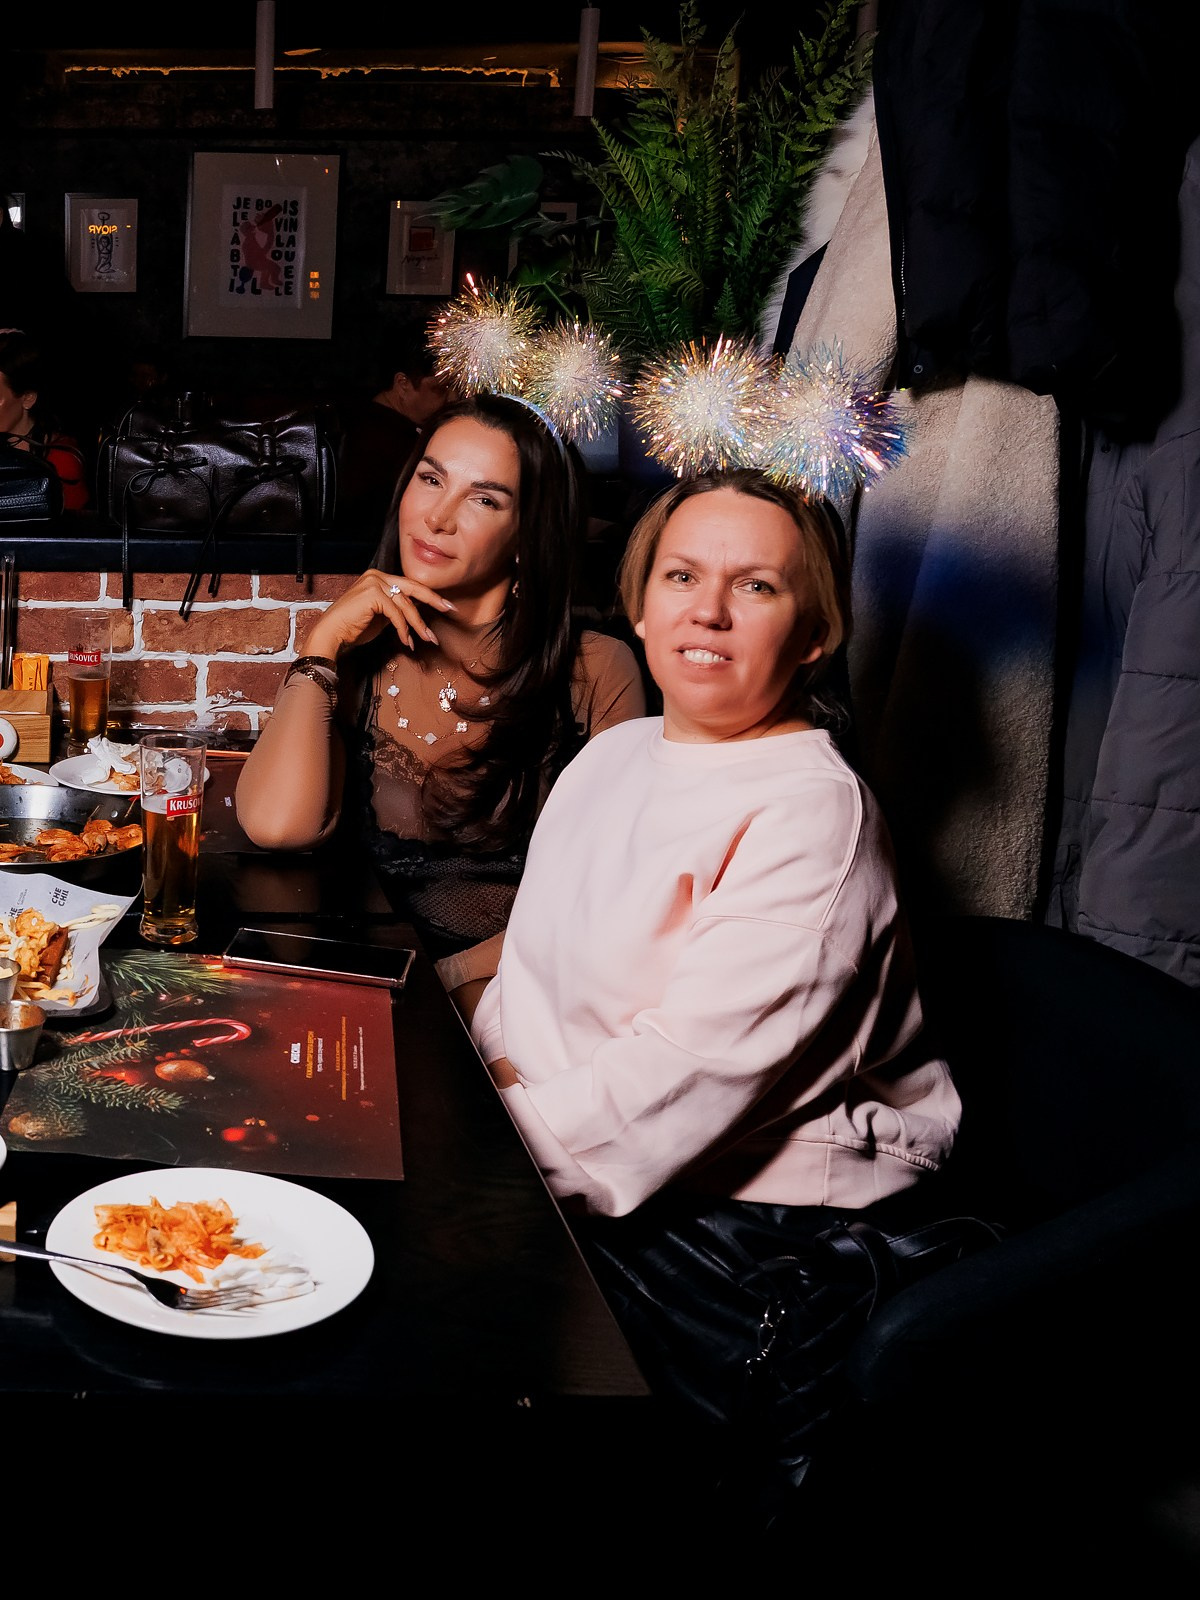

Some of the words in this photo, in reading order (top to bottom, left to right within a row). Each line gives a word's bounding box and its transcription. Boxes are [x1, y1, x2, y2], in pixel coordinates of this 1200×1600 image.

[232, 196, 251, 210] JE
[275, 218, 298, 233] VIN
[275, 235, 296, 248] LA
[51, 887, 62, 904] CHE
